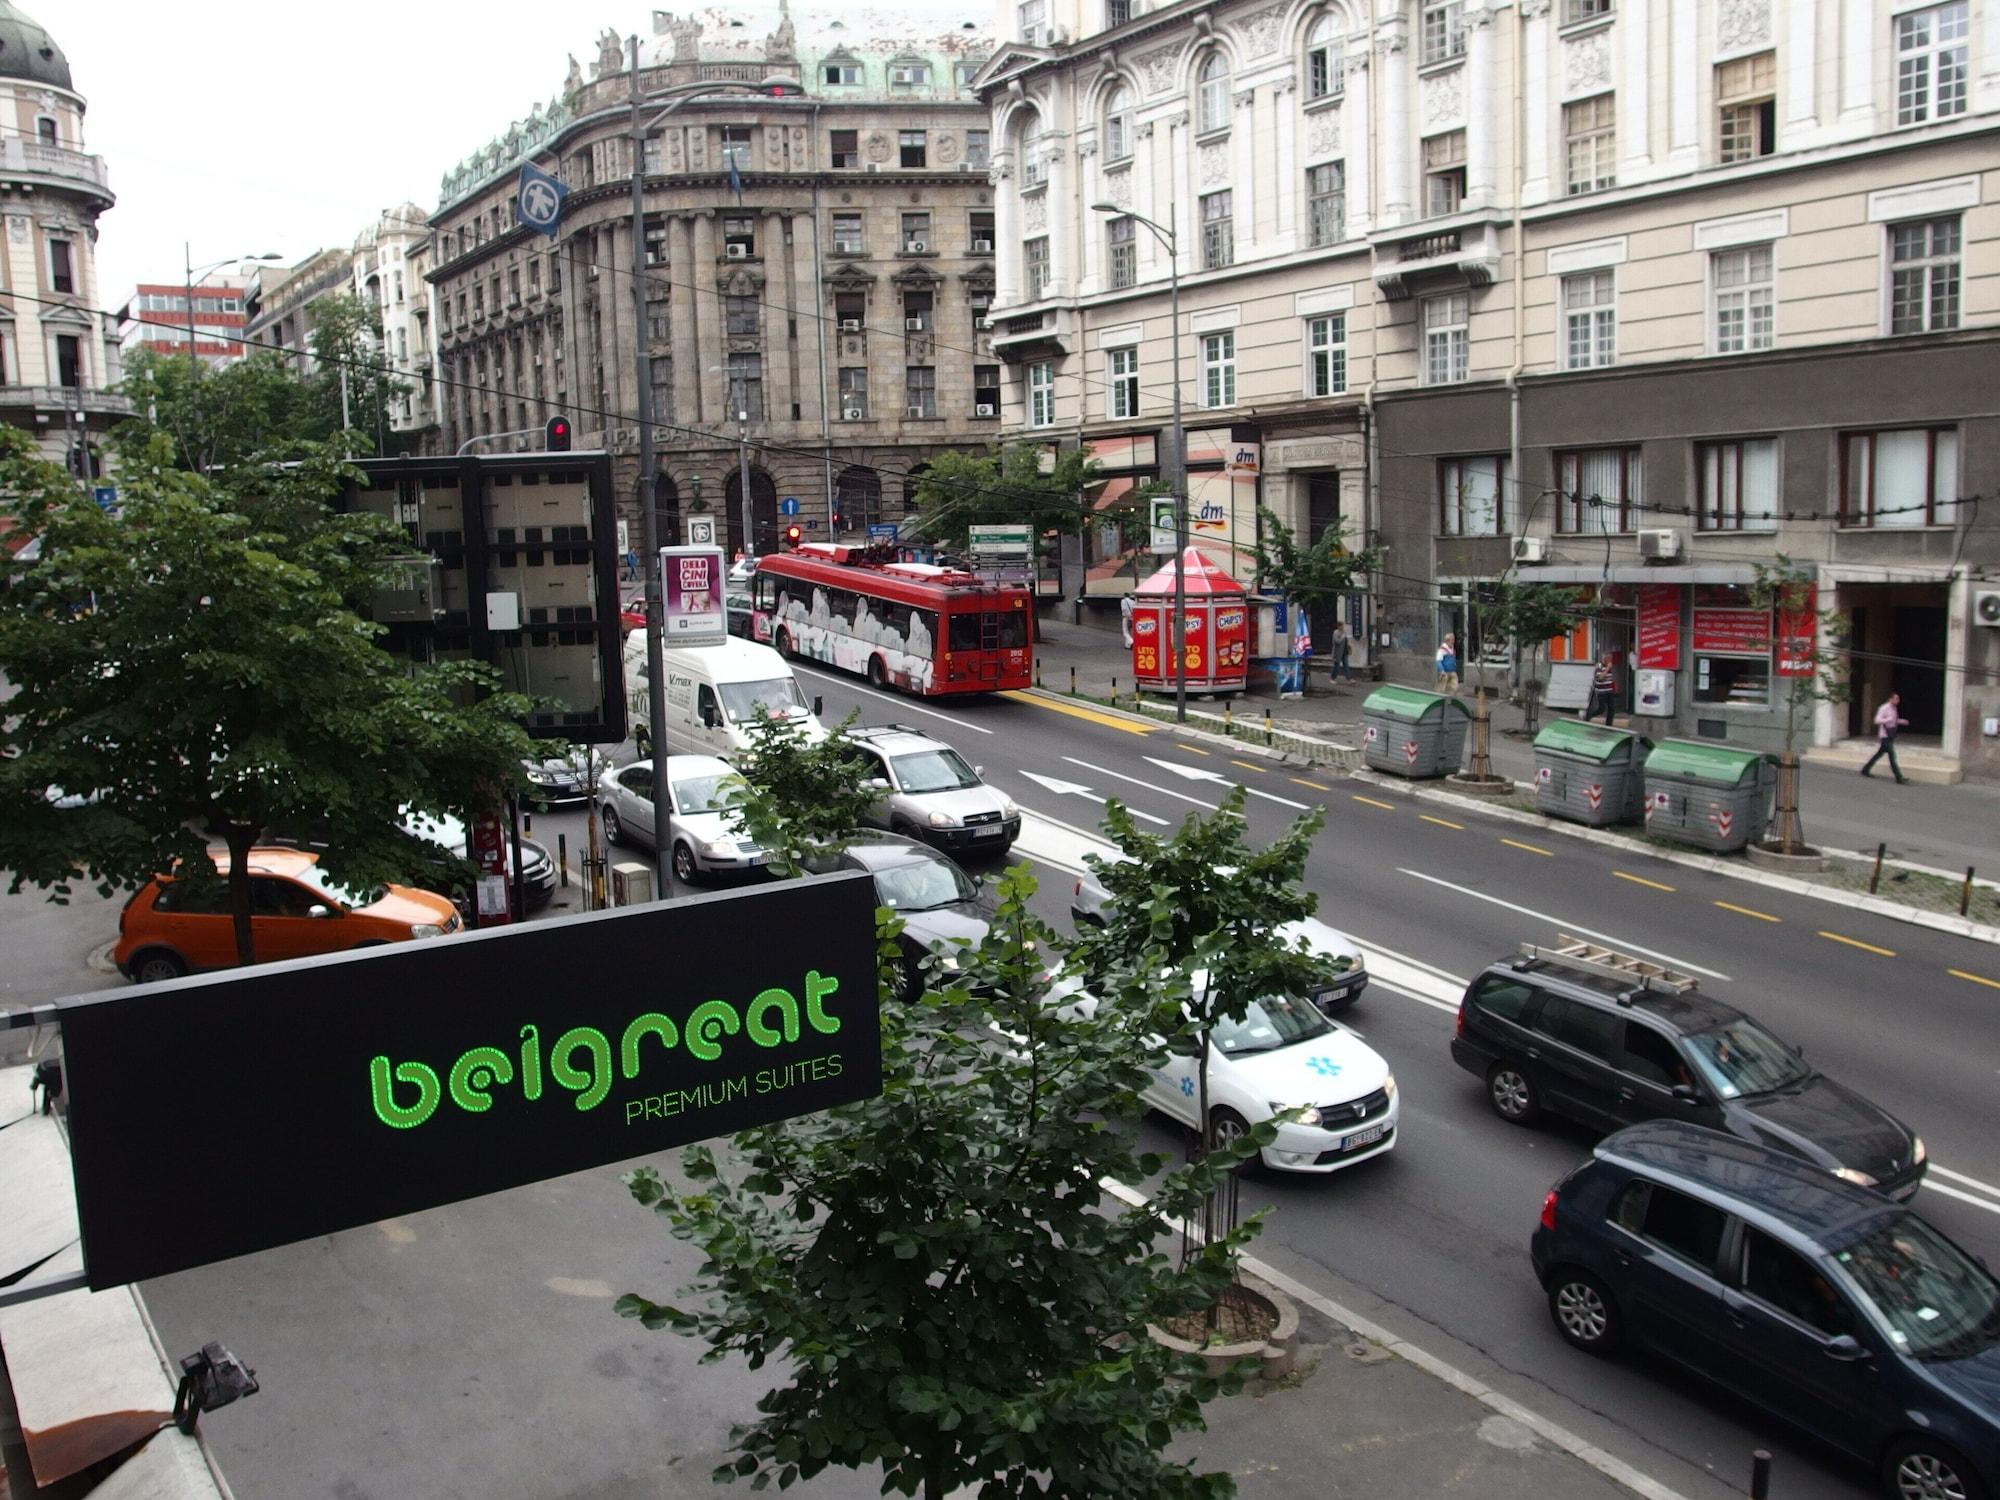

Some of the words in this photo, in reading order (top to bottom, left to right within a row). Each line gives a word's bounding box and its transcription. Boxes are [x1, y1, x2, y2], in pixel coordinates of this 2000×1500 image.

[1236, 448, 1254, 463] dm
[1200, 500, 1224, 520] dm
[682, 560, 706, 569] DELO
[1219, 614, 1243, 627] CHIPSY
[1138, 646, 1155, 655] LETO
[625, 1075, 748, 1126] PREMIUM
[755, 1053, 843, 1094] SUITES
